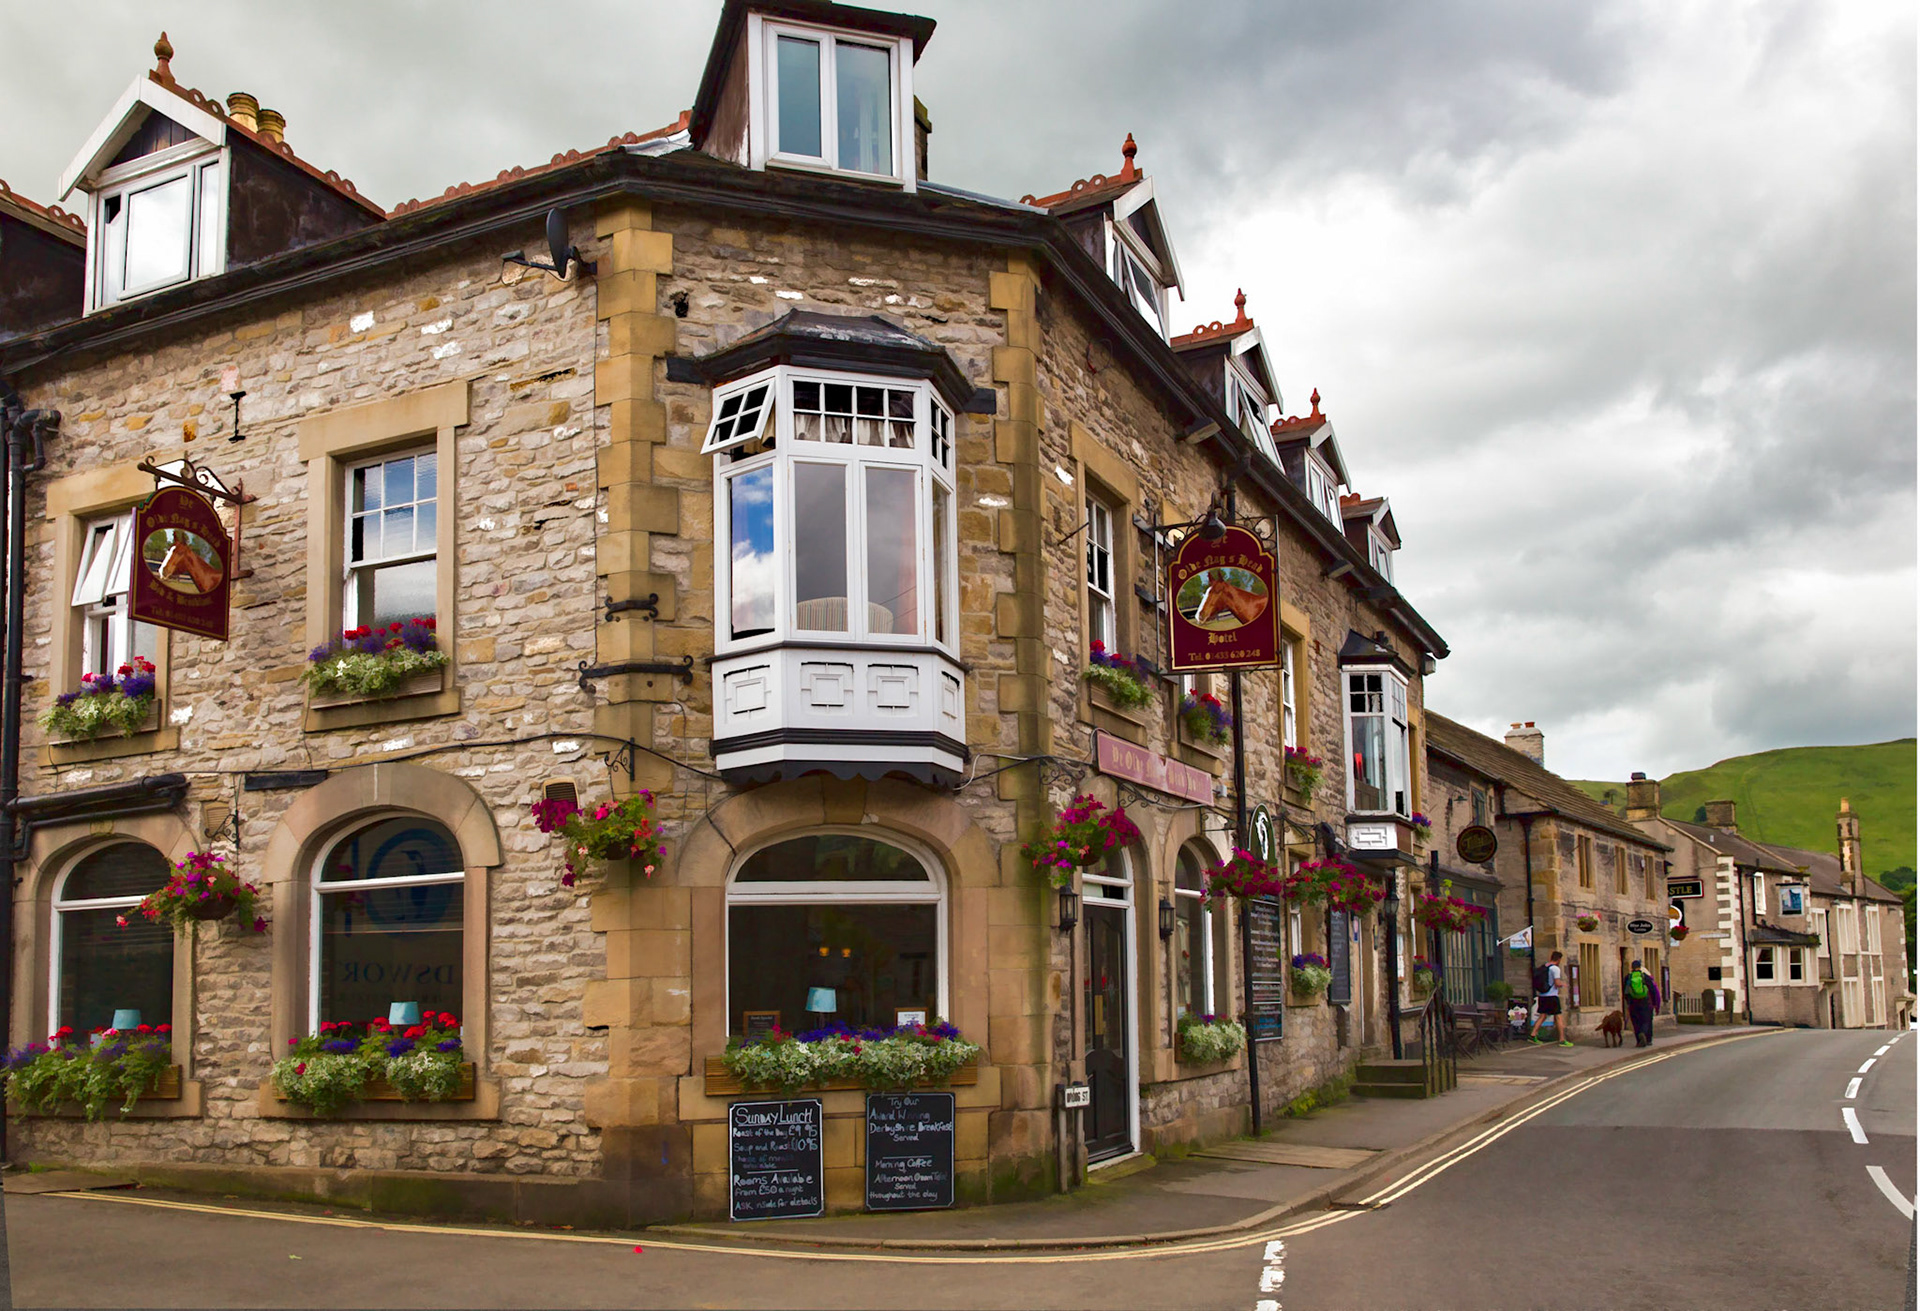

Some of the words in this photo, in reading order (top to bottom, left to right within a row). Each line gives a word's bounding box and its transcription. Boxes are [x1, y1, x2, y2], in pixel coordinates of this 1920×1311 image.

[1178, 561, 1202, 580] Olde
[1236, 554, 1263, 573] Head
[1208, 631, 1238, 646] Hotel
[1230, 650, 1245, 658] 620
[1669, 886, 1693, 895] STLE
[888, 1097, 902, 1109] Try
[904, 1097, 920, 1106] Our
[870, 1122, 916, 1136] Derbyshre
[875, 1160, 906, 1173] Mornng
[907, 1158, 932, 1168] Coffee
[734, 1174, 768, 1186] Rooms
[771, 1173, 814, 1184] Aalabe
[758, 1184, 778, 1195] £50
[922, 1190, 938, 1202] day
[755, 1200, 776, 1208] nside
